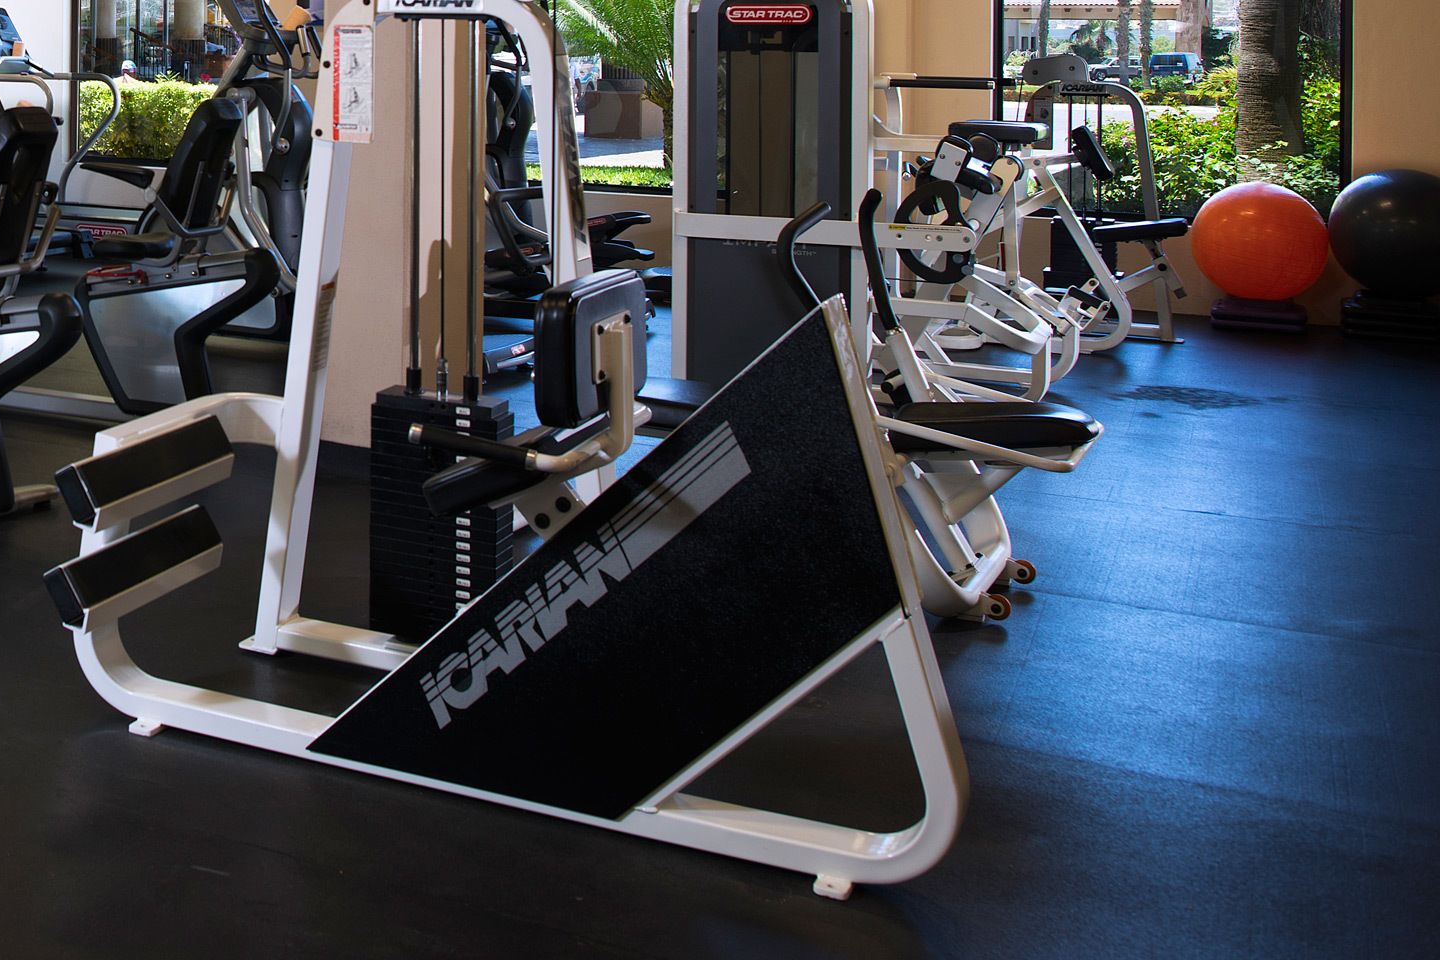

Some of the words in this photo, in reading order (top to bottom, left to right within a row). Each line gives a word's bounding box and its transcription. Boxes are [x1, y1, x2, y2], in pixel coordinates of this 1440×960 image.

[730, 10, 766, 19] STAR
[767, 10, 804, 19] TRAC
[1062, 84, 1104, 92] ICARIAN
[419, 520, 634, 730] ICARIAN
